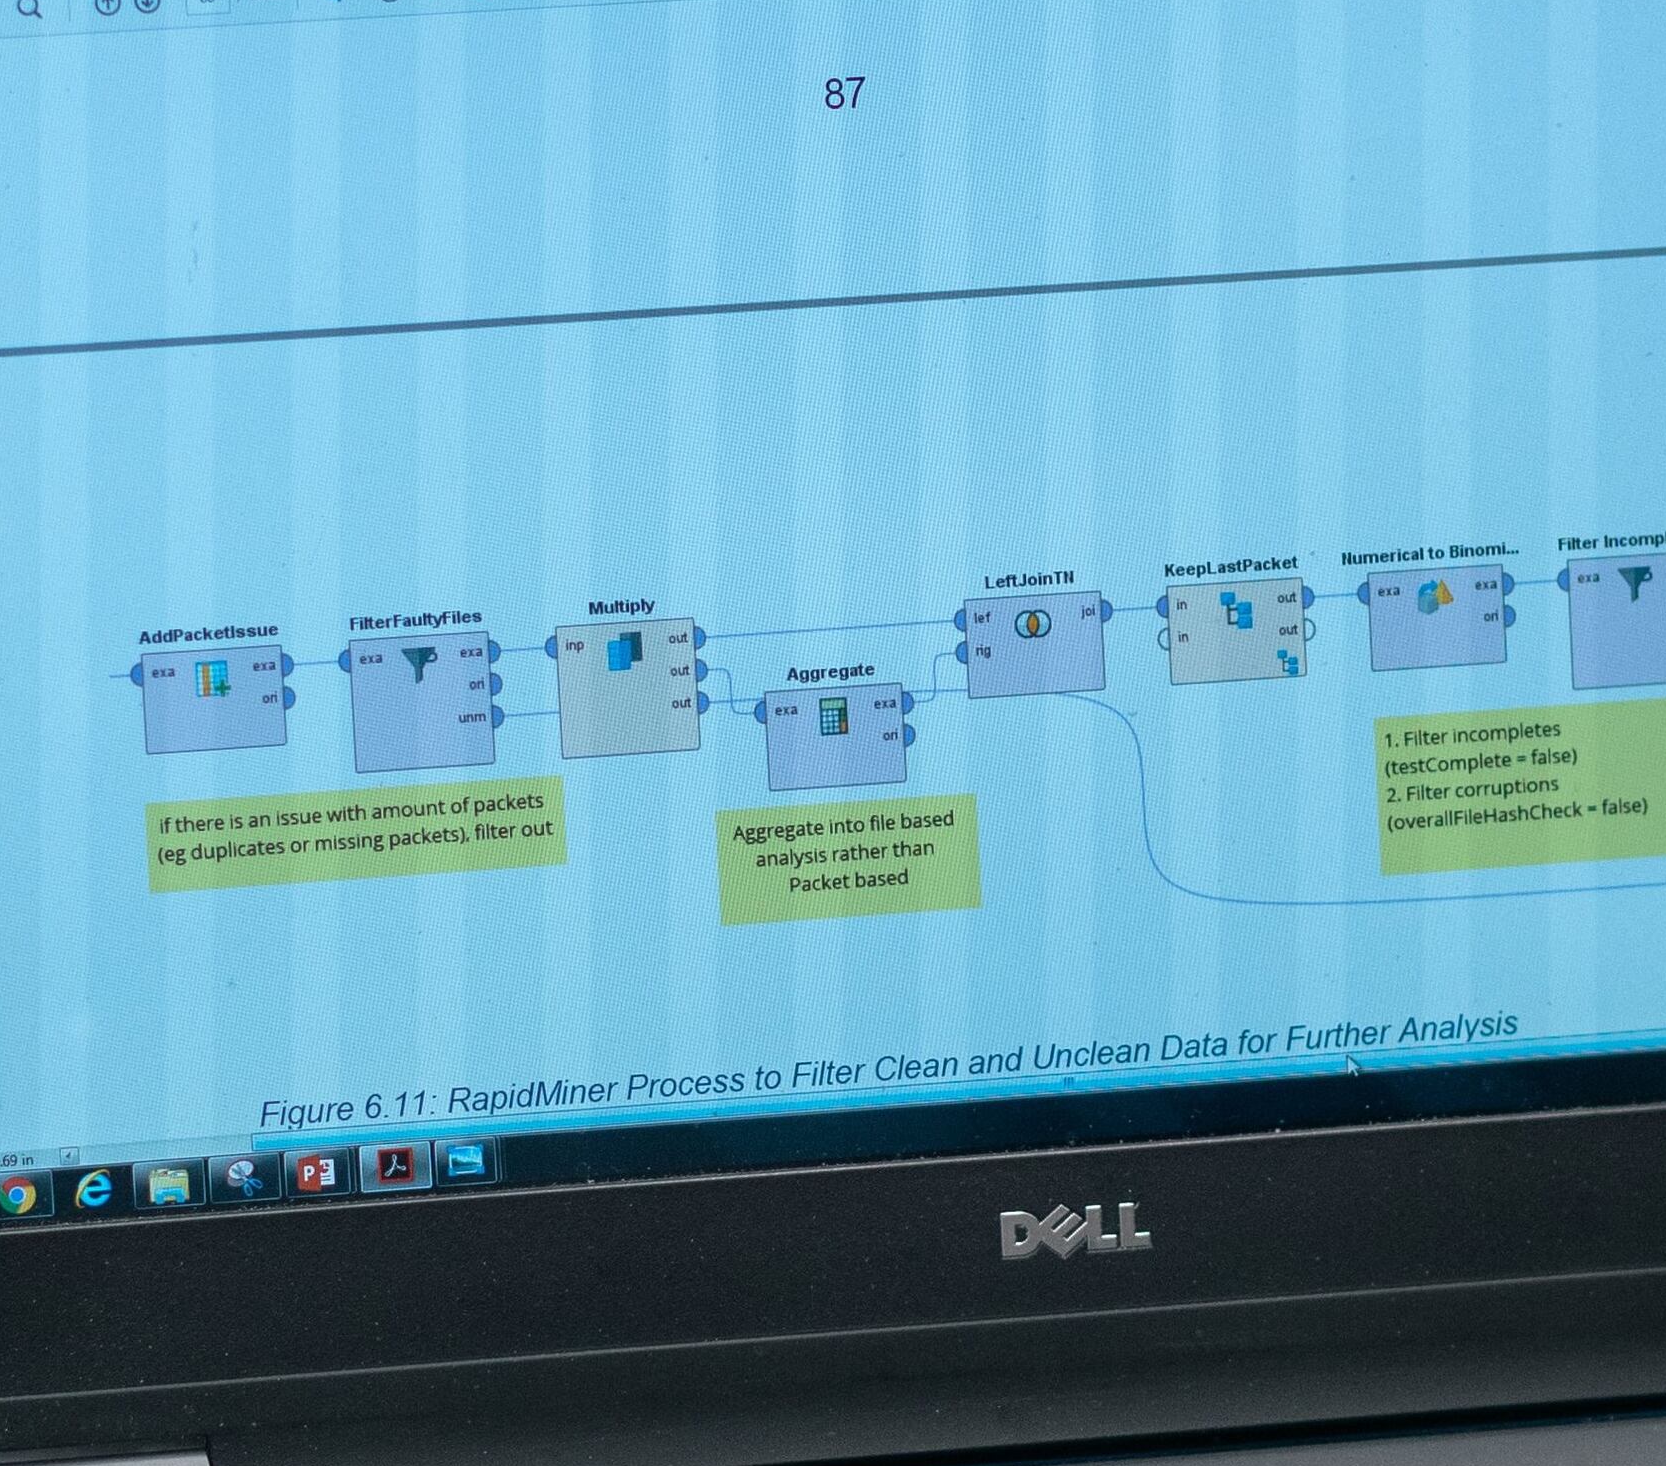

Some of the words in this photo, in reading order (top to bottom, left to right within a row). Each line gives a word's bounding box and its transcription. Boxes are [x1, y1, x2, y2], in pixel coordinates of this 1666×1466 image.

[824, 76, 866, 110] 87
[1341, 545, 1425, 566] Numerical
[1428, 546, 1445, 561] to
[1558, 535, 1599, 552] Filter
[984, 569, 1075, 590] LeftJoinTN
[1164, 556, 1299, 579] KeepLastPacket
[1475, 579, 1498, 591] exa
[588, 598, 655, 616] Multiply
[1277, 592, 1297, 605] out
[349, 610, 483, 632] FilterFaultyFiles
[139, 623, 279, 645] AddPacketIssue
[565, 638, 585, 654] inp
[786, 662, 875, 683] Aggregate
[1384, 732, 1400, 748] 1.
[1404, 728, 1446, 747] Filter
[1452, 721, 1561, 745] incompletes
[1385, 752, 1512, 778] (testComplete
[1531, 747, 1578, 767] false)
[1386, 787, 1402, 803] 2.
[1406, 782, 1450, 802] Filter
[1455, 775, 1559, 800] corruptions
[175, 814, 225, 834] there
[229, 812, 244, 830] is
[249, 814, 271, 829] an
[276, 809, 322, 827] issue
[327, 805, 367, 824] with
[372, 801, 446, 821] amount
[450, 797, 471, 815] of
[474, 792, 545, 817] packets
[1387, 801, 1582, 833] (overallFileHashCheck
[1602, 796, 1648, 817] false)
[733, 820, 824, 845] Aggregate
[829, 817, 865, 835] into
[870, 814, 896, 832] file
[901, 809, 955, 830] based
[157, 847, 187, 866] (eg
[191, 838, 285, 863] duplicates
[290, 839, 311, 854] or
[315, 832, 385, 854] missing
[474, 822, 516, 841] filter
[521, 820, 554, 838] out
[756, 848, 827, 870] analysis
[832, 843, 887, 863] rather
[893, 840, 935, 859] than
[789, 872, 851, 893] Packet
[855, 868, 909, 889] based
[259, 1095, 354, 1131] Figure
[364, 1089, 436, 1120] 6.11:
[447, 1078, 618, 1116] RapidMiner
[627, 1070, 745, 1101] Process
[755, 1064, 781, 1091] to
[792, 1059, 866, 1088] Filter
[875, 1052, 959, 1082] Clean
[968, 1044, 1023, 1074] and
[1034, 1036, 1150, 1070] Unclean
[1160, 1032, 1228, 1061] Data
[1238, 1028, 1277, 1055] for
[1286, 1020, 1391, 1051] Further
[1398, 1010, 1519, 1043] Analysis
[22, 1152, 34, 1167] in
[1000, 1202, 1153, 1260] DELL
